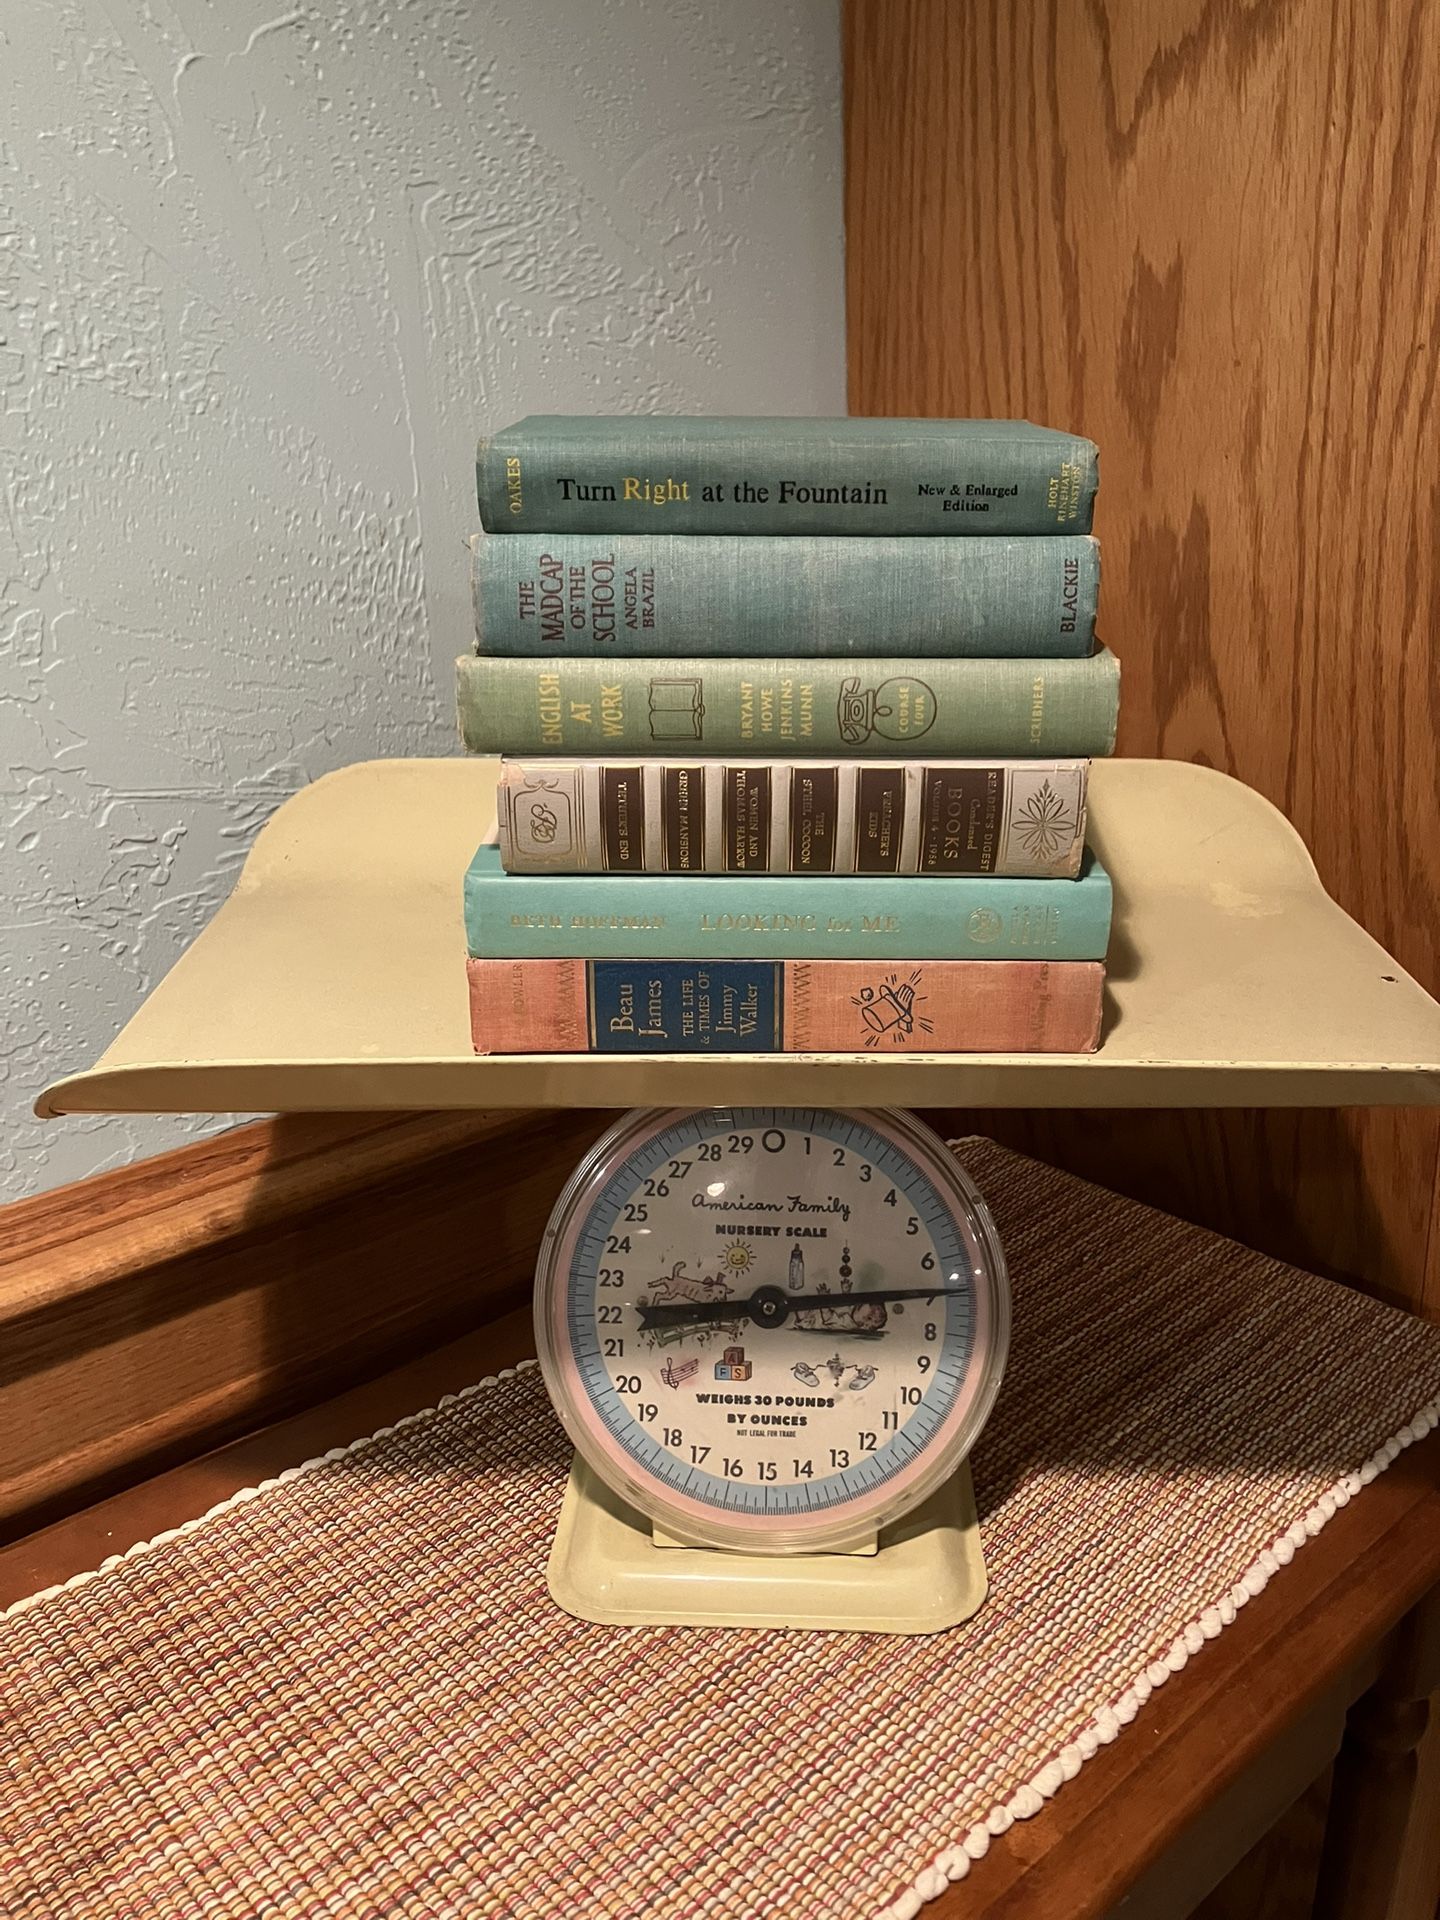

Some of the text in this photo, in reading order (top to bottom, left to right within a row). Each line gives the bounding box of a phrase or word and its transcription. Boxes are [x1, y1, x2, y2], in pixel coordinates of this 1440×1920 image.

[507, 457, 521, 513] OAKES
[557, 477, 888, 505] Turn Right at the Fountain
[918, 484, 1018, 498] New & Enlarged
[1048, 477, 1059, 508] HOLT
[1057, 462, 1070, 521] RINEHART
[1069, 466, 1080, 518] WINSTON
[943, 501, 990, 512] Edition
[519, 581, 534, 619] THE
[540, 554, 565, 642] MADCAP
[570, 566, 585, 629] OF THE
[593, 553, 616, 642] SCHOOL
[625, 567, 638, 630] ANGELA
[643, 568, 655, 628] BRAZIL
[1061, 558, 1078, 633] BLACKIE
[539, 673, 563, 745] ENGLISH
[571, 701, 592, 723] AT
[602, 684, 624, 738] WORK
[740, 681, 753, 739] BRYANT
[761, 688, 773, 732] HOWE
[779, 679, 795, 741] JENKINS
[800, 684, 813, 737] MUNN
[899, 686, 909, 733] COURSE
[914, 695, 925, 725] FOUR
[931, 779, 942, 824] VOLUME
[679, 770, 689, 870] GREEN MANSIONS
[736, 770, 747, 870] THOMAS HARROW
[750, 786, 759, 857] WOMEN AND
[815, 812, 825, 836] THE
[869, 812, 878, 839] KIDS
[880, 790, 893, 857] PREACHER'S
[944, 787, 963, 859] BOOKS
[967, 799, 981, 850] Condensed
[979, 771, 997, 871] READER'S DIGEST
[619, 839, 629, 861] END
[801, 819, 811, 865] COCOON
[700, 913, 900, 933] LOOKING for ME
[611, 983, 634, 1033] Beau
[638, 979, 669, 1038] James
[682, 979, 694, 1036] THE LIFE
[699, 970, 710, 1045] & TIMES OF
[716, 984, 738, 1034] Jimmy
[740, 983, 759, 1037] Walker
[697, 1143, 722, 1162] 28
[728, 1135, 754, 1154] 29
[804, 1137, 811, 1155] 1
[833, 1148, 845, 1166] 2
[668, 1160, 693, 1179] 27
[859, 1164, 872, 1182] 3
[643, 1179, 669, 1197] 26
[884, 1189, 897, 1207] 4
[624, 1204, 648, 1222] 25
[691, 1194, 851, 1222] American Family
[715, 1224, 828, 1238] NURSERY SCALE
[906, 1216, 919, 1235] 5
[606, 1235, 632, 1254] 24
[921, 1252, 934, 1270] 6
[599, 1269, 624, 1287] 23
[598, 1306, 623, 1324] 22
[924, 1323, 937, 1341] 8
[604, 1338, 624, 1357] 21
[728, 1352, 736, 1363] A
[719, 1367, 727, 1377] F
[734, 1368, 742, 1379] S
[917, 1355, 931, 1374] 9
[615, 1375, 642, 1394] 20
[900, 1386, 922, 1405] 10
[696, 1393, 835, 1408] WEIGHS 30 POUNDS
[638, 1403, 658, 1422] 19
[727, 1413, 808, 1427] BY OUNCES
[882, 1411, 898, 1430] 11
[663, 1428, 683, 1447] 18
[736, 1429, 747, 1437] NOT
[749, 1429, 765, 1437] LEGAL
[779, 1430, 797, 1438] TRADE
[858, 1432, 877, 1451] 12
[690, 1445, 712, 1464] 17
[829, 1449, 850, 1468] 13
[722, 1458, 743, 1477] 16
[757, 1462, 777, 1481] 15
[793, 1460, 814, 1479] 14
